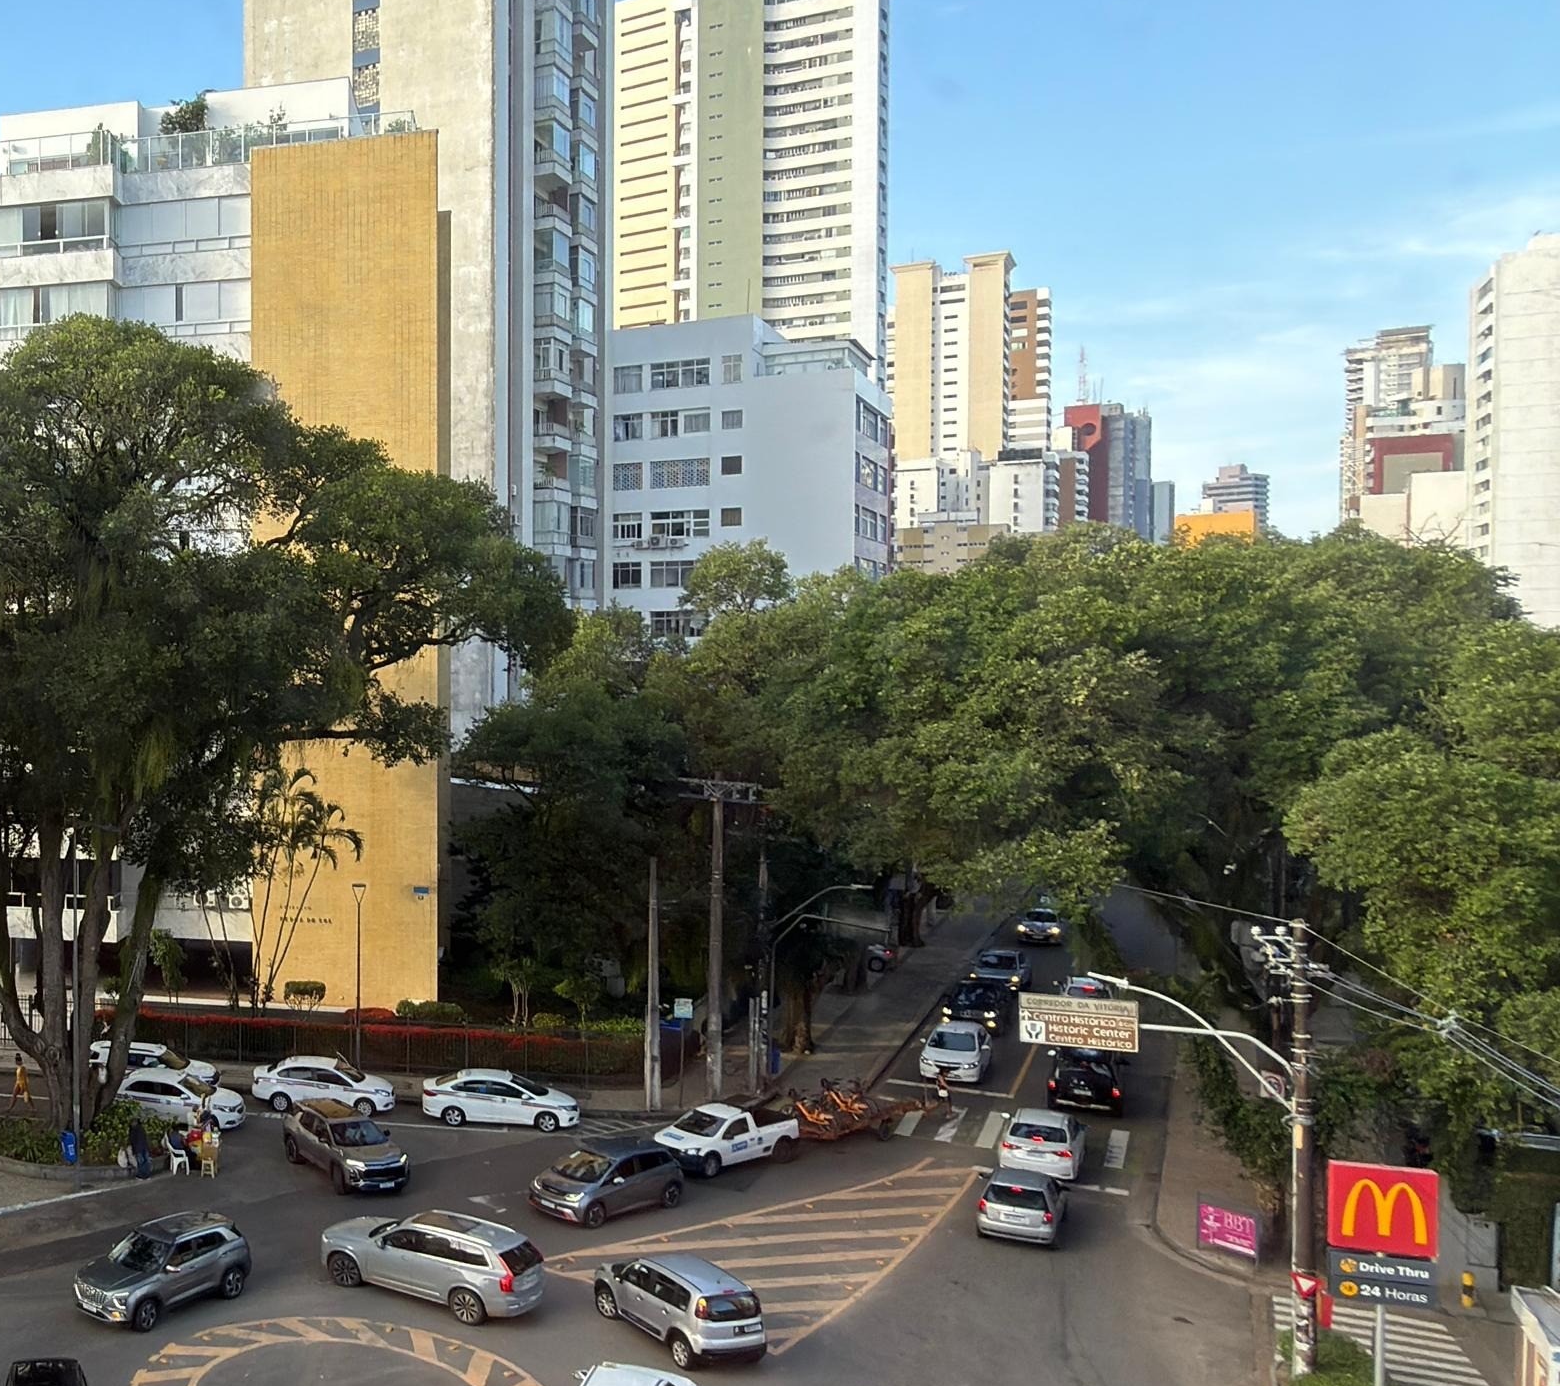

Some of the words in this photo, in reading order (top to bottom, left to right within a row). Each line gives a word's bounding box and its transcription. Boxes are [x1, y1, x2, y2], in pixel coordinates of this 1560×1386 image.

[1033, 1012, 1069, 1023] Centro
[1049, 1024, 1090, 1036] Historic
[1093, 1027, 1132, 1039] Center
[1048, 1034, 1084, 1045] Centro
[1359, 1261, 1396, 1275] Drive
[1396, 1265, 1430, 1279] Thru
[1360, 1284, 1382, 1298] 24
[1384, 1287, 1428, 1304] Horas
